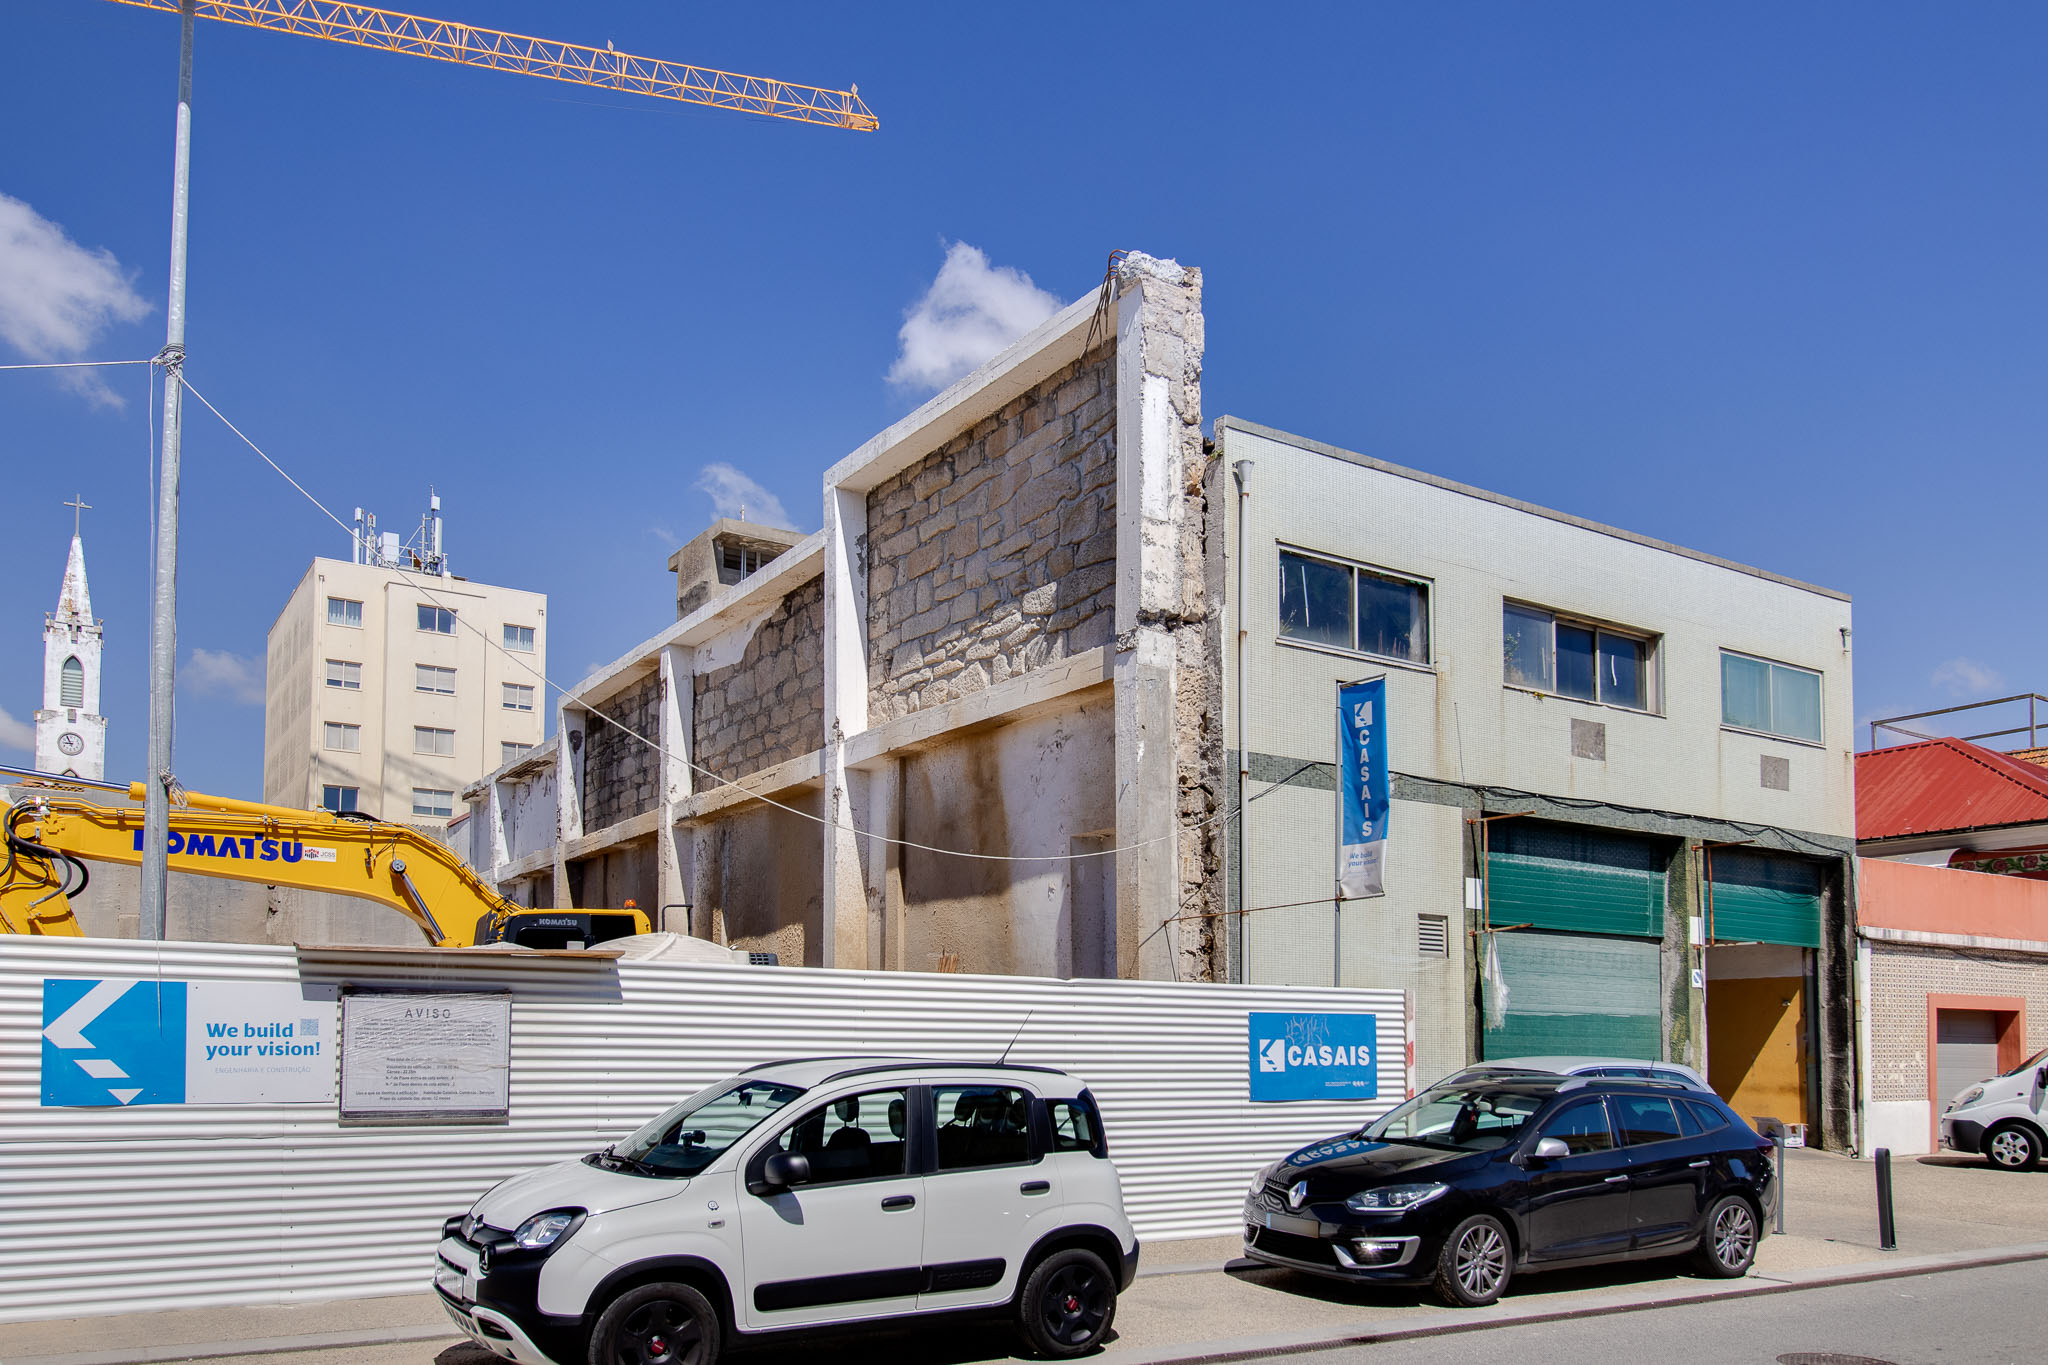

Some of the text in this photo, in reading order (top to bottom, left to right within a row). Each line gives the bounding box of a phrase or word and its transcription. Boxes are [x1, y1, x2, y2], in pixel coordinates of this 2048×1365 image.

[1359, 730, 1373, 837] CASAIS
[539, 918, 577, 926] KOMATSU
[405, 1008, 451, 1019] AVISO
[206, 1022, 294, 1038] We build
[206, 1041, 321, 1061] your vision!
[1287, 1045, 1370, 1066] CASAIS
[215, 1066, 259, 1074] ENGENHARIA
[266, 1064, 311, 1075] CONSTRUÇÃO
